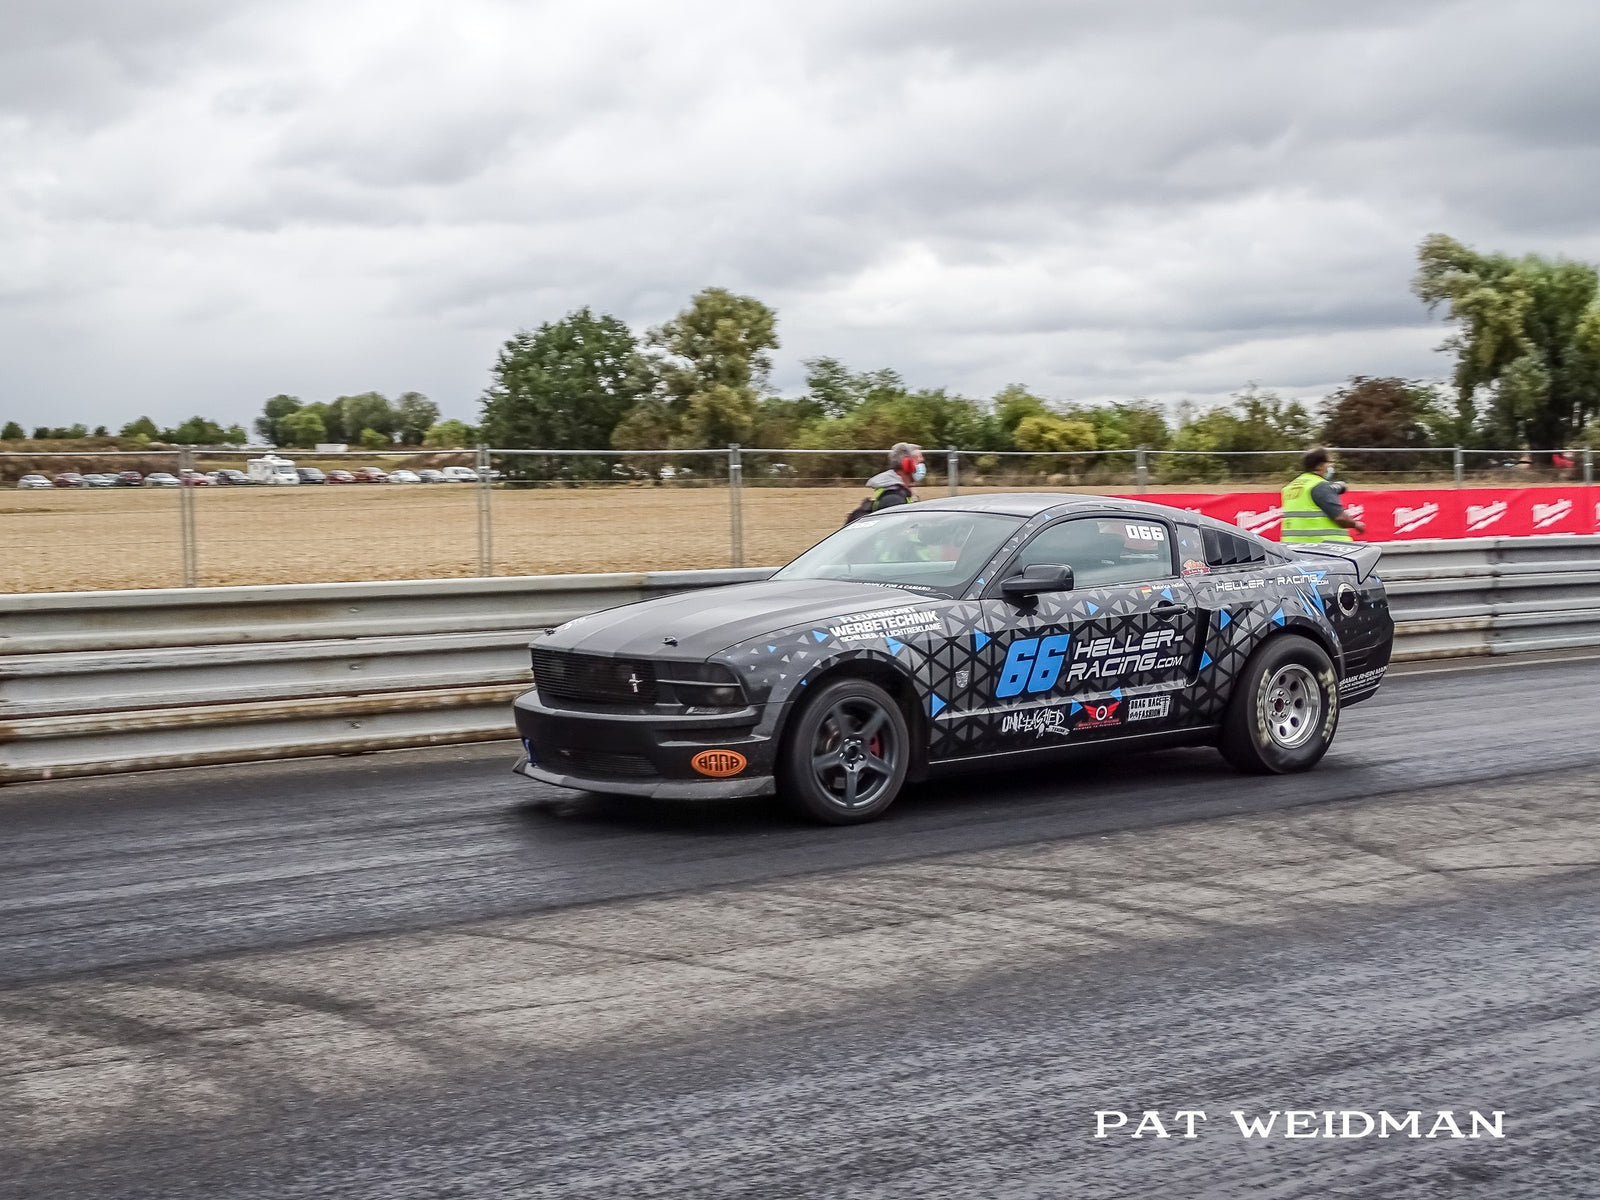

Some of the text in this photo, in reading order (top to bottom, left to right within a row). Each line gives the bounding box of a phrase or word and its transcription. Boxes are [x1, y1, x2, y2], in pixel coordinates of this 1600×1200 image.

[1125, 525, 1164, 541] 066
[1215, 578, 1265, 592] HELLER
[829, 610, 940, 637] WERBETECHNIK
[840, 606, 917, 624] FLEURMONT
[884, 622, 942, 638] LICHTREKLAME
[1074, 629, 1184, 660] HELLER-
[995, 634, 1070, 698] 66
